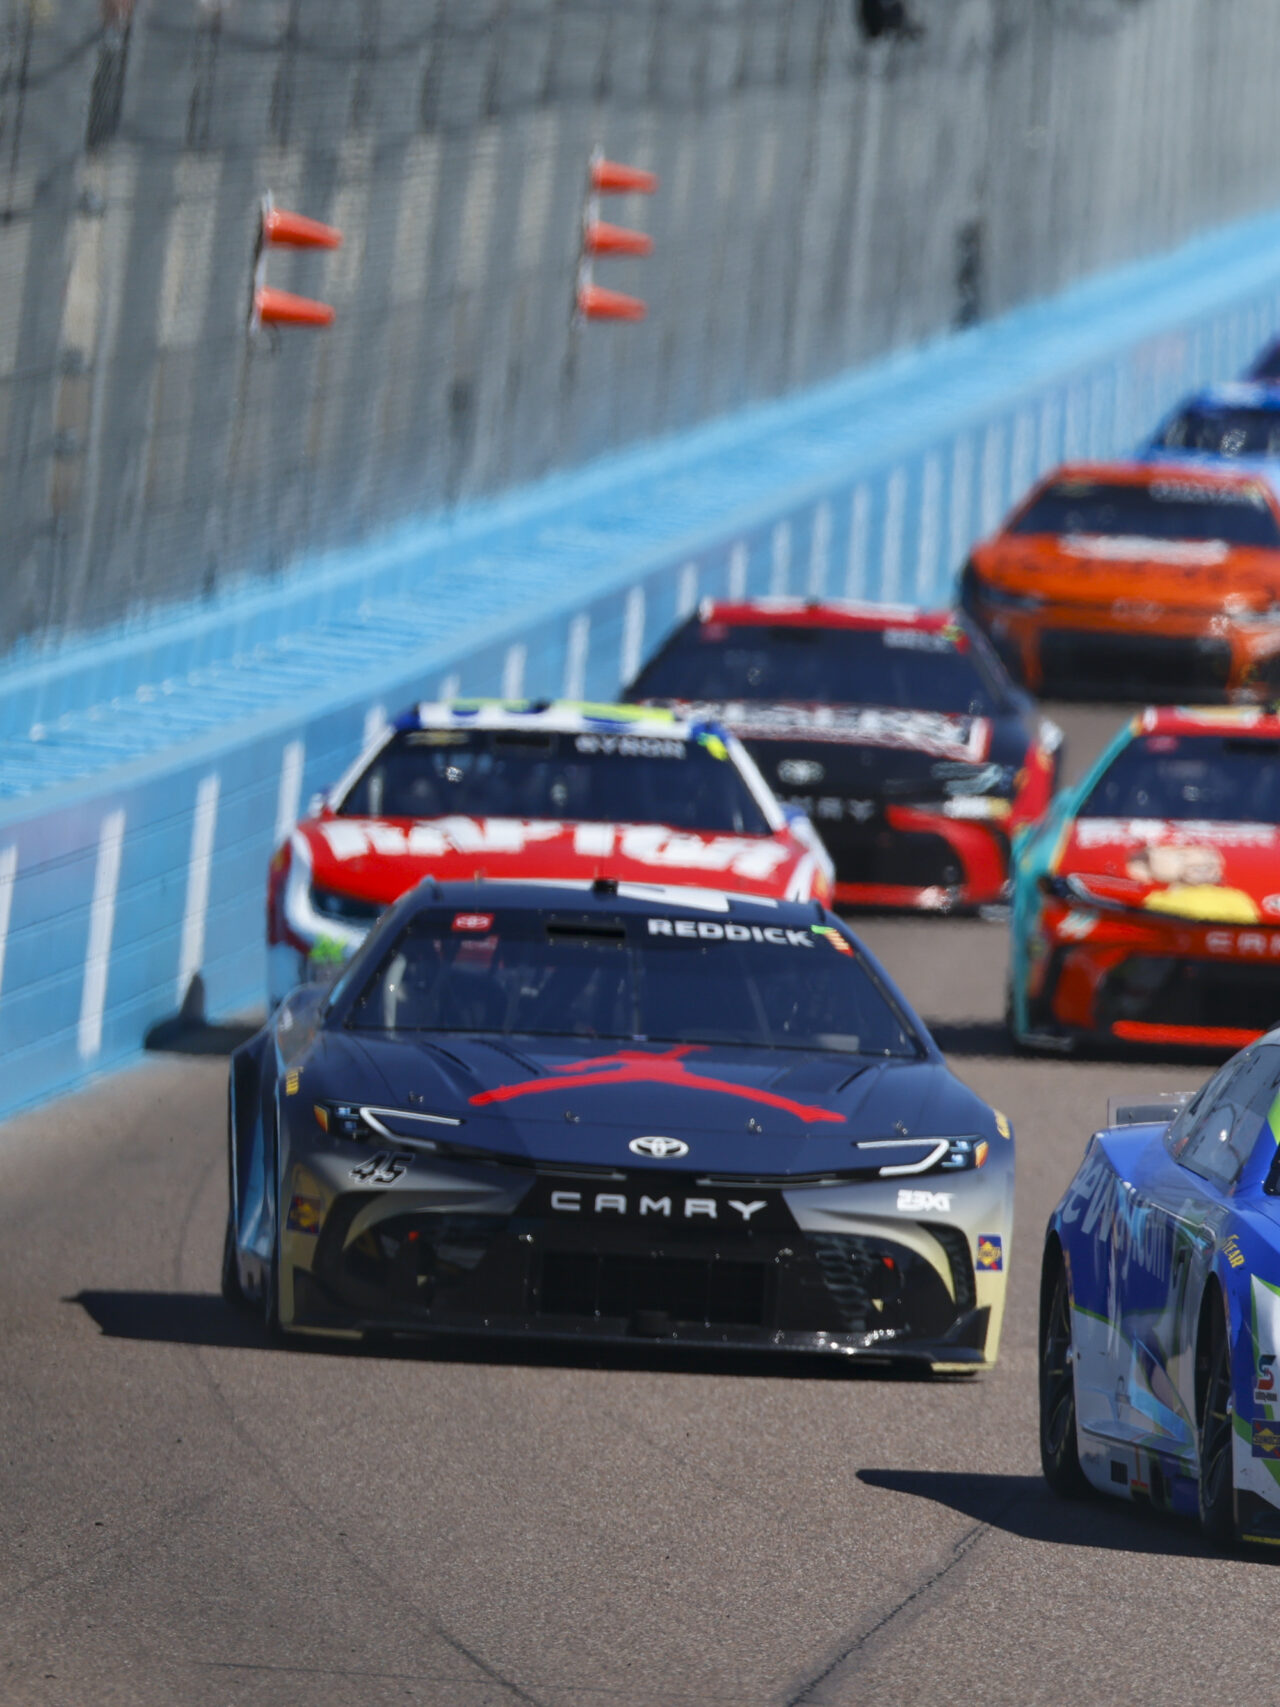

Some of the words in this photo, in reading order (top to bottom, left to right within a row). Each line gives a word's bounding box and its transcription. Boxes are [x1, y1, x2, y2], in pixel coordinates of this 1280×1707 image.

[647, 918, 815, 948] REDDICK
[349, 1152, 415, 1186] 45
[551, 1191, 768, 1221] CAMRY
